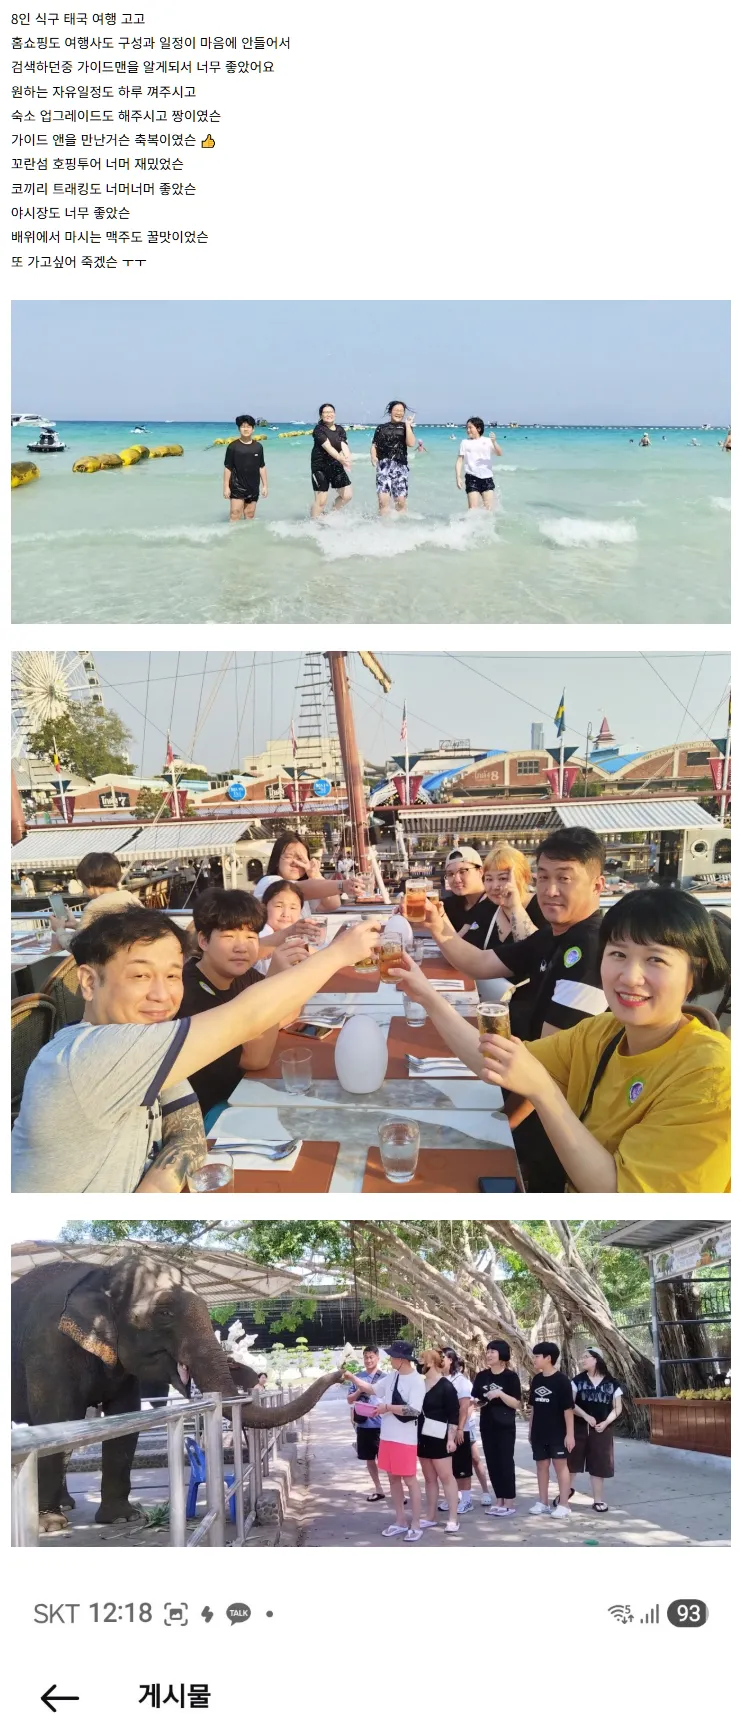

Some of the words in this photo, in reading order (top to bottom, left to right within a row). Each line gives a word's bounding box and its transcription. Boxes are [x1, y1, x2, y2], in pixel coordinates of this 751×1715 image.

[34, 1604, 80, 1623] SKT
[90, 1603, 152, 1622] 12:18
[230, 1609, 248, 1617] TALK
[677, 1604, 701, 1622] 93
[138, 1683, 212, 1709] 게시물
